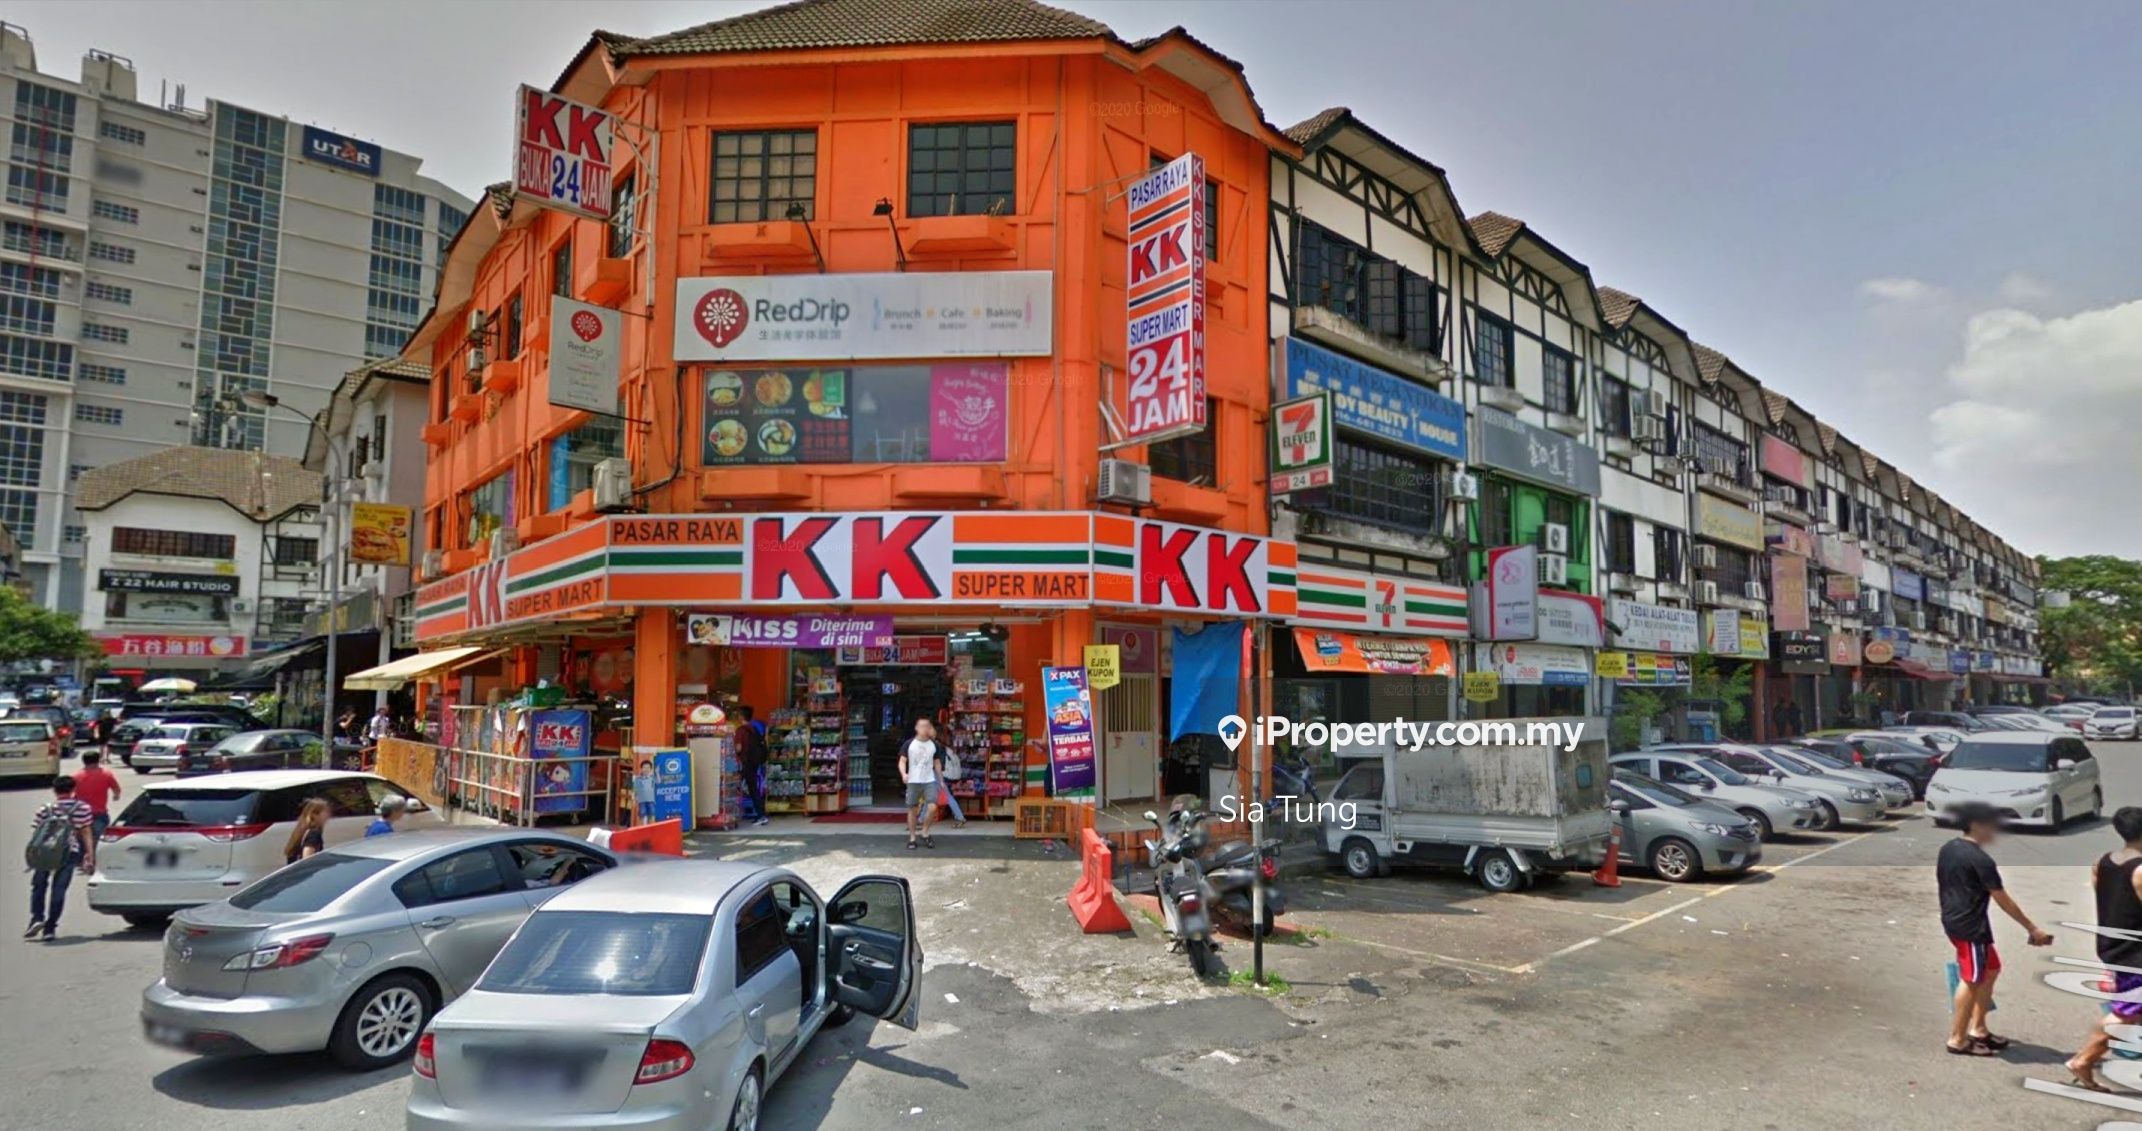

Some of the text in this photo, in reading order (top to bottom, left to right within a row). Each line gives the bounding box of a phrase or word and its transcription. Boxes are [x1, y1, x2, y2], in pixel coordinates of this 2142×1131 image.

[526, 90, 607, 162] KK
[312, 139, 371, 165] UTAR
[520, 144, 610, 212] BUKA 24 JAM
[1131, 160, 1188, 210] PASAR RAYA
[1192, 160, 1202, 202] KK
[1131, 223, 1188, 285] KK
[755, 297, 850, 328] RedDrip
[884, 307, 1022, 321] Brunch Cafe Baking
[1130, 304, 1189, 346] SUPER MART
[1130, 336, 1189, 401] 24
[1130, 390, 1189, 432] JAM
[1358, 400, 1409, 430] BEAUTY
[1281, 402, 1315, 464] 7
[1293, 475, 1306, 487] 24
[613, 521, 739, 542] PASAR RAYA
[752, 516, 942, 600] KK
[1141, 523, 1262, 612] KK
[145, 578, 180, 589] HAIR
[182, 580, 232, 592] STUDIO
[467, 558, 505, 628] KK
[507, 578, 603, 619] SUPER MART
[958, 574, 1089, 597] SUPER MART
[1375, 580, 1396, 628] 7
[733, 618, 798, 639] KISS
[810, 618, 875, 633] Diterima
[820, 632, 836, 646] di
[837, 632, 864, 646] sini
[883, 647, 899, 662] 24
[1090, 657, 1111, 668] EJEN
[1088, 667, 1115, 678] KUPON
[542, 724, 575, 740] KK
[1053, 735, 1091, 746] TERBAIK
[656, 786, 690, 796] ACCEPTED
